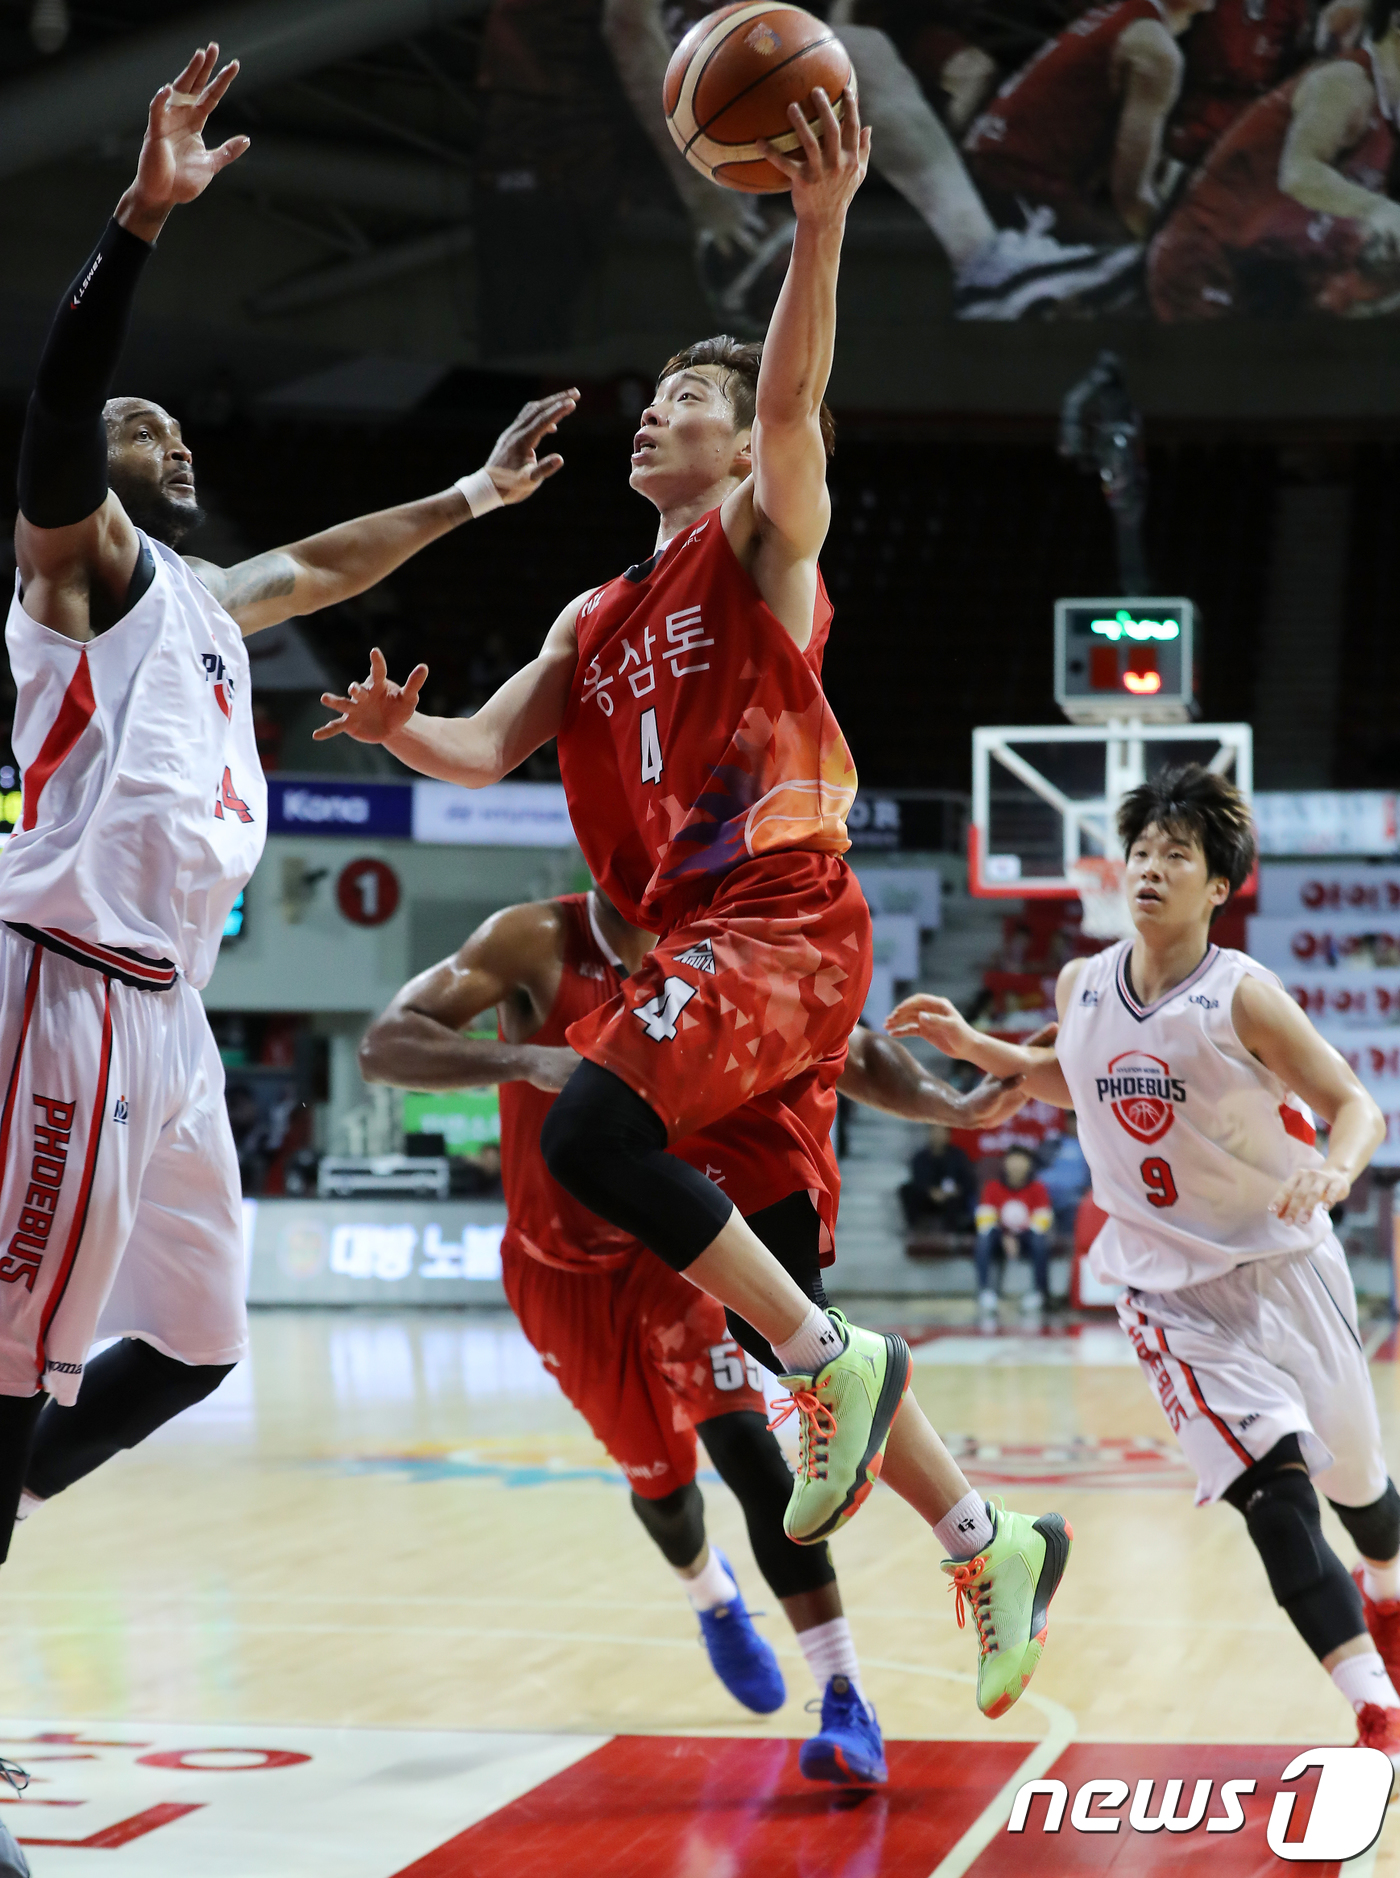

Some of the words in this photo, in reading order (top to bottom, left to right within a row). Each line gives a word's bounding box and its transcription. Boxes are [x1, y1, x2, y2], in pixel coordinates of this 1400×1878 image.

[581, 604, 715, 717] 홍삼톤
[638, 705, 664, 785] 4
[213, 764, 255, 824] 4
[354, 871, 379, 917] 1
[631, 975, 698, 1043] 4
[1095, 1076, 1187, 1103] PHOEBUS
[0, 1093, 77, 1294] PHOEBUS
[1139, 1156, 1179, 1209] 9
